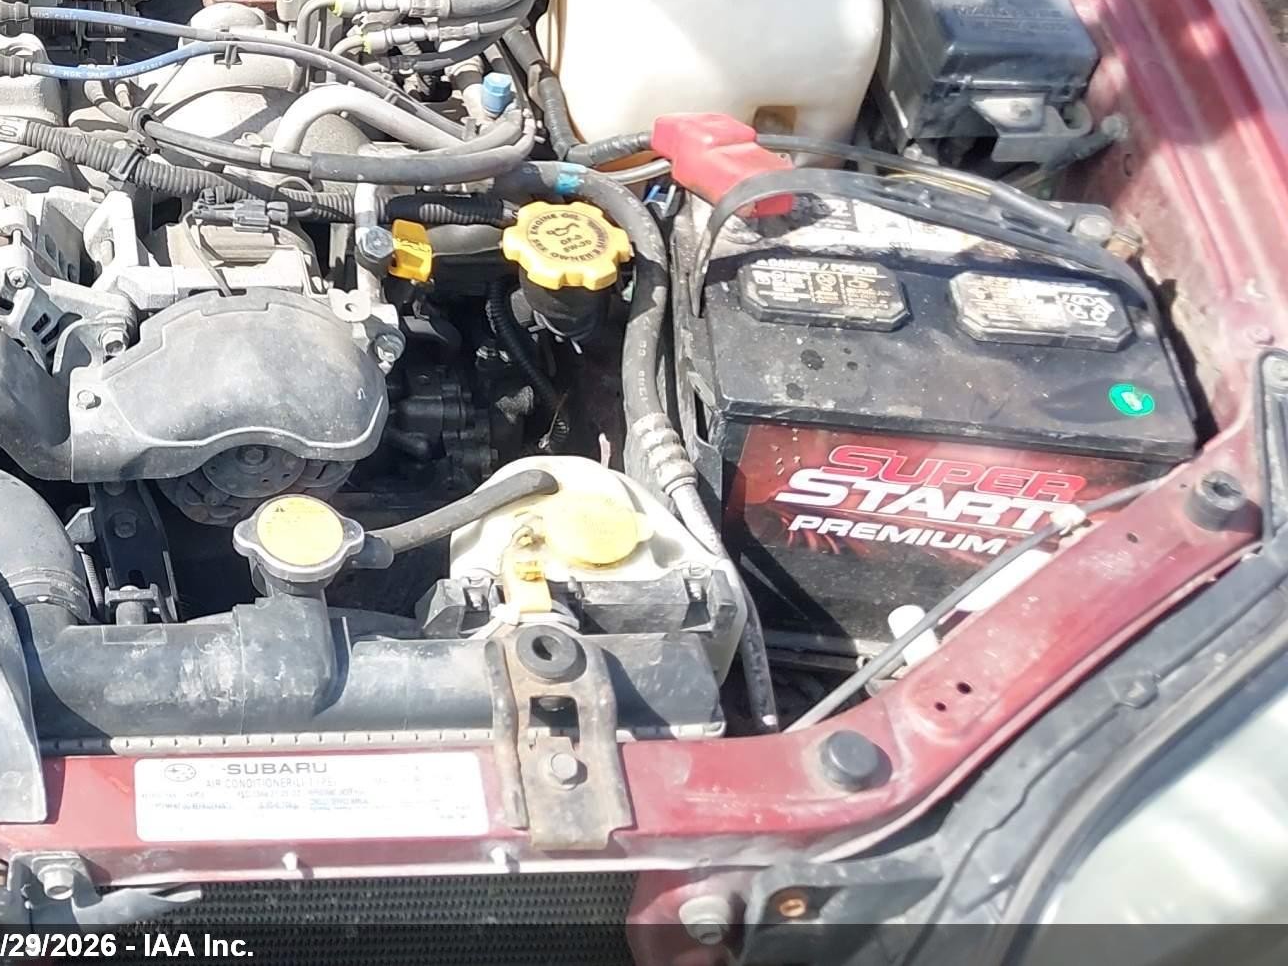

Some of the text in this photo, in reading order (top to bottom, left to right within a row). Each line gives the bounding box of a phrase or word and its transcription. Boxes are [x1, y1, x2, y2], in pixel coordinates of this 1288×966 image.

[530, 212, 582, 235] ENGINE OIL
[821, 445, 1086, 502] SUPER
[775, 468, 1074, 532] START
[788, 514, 1007, 555] PREMIUM
[226, 762, 328, 775] SUBARU
